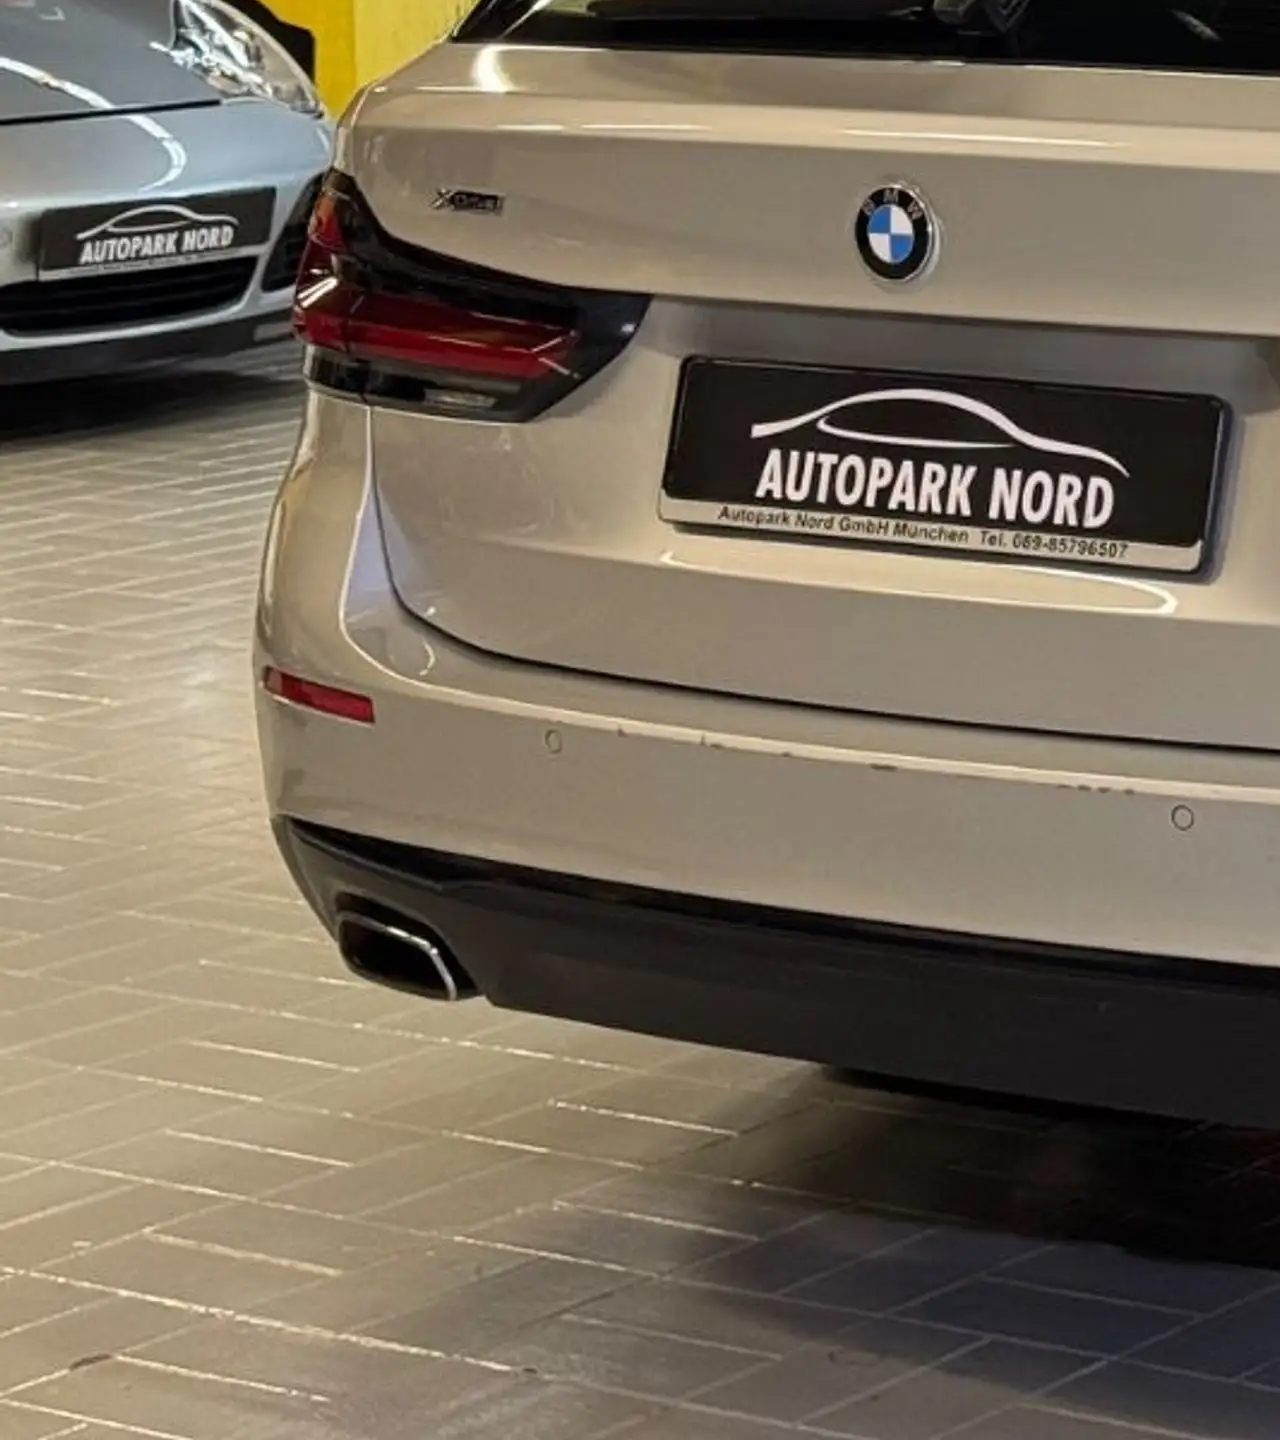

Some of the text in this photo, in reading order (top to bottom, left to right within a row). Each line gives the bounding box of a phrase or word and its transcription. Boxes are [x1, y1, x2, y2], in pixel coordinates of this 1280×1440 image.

[78, 230, 179, 266] AUTOPARK
[181, 225, 235, 252] NORD
[755, 448, 1115, 529] AUTOPARK NORD
[717, 506, 791, 528] Autopark
[794, 512, 834, 530] Nord
[837, 515, 890, 536] GmbH
[892, 520, 969, 544] München
[980, 530, 1007, 547] Tel.
